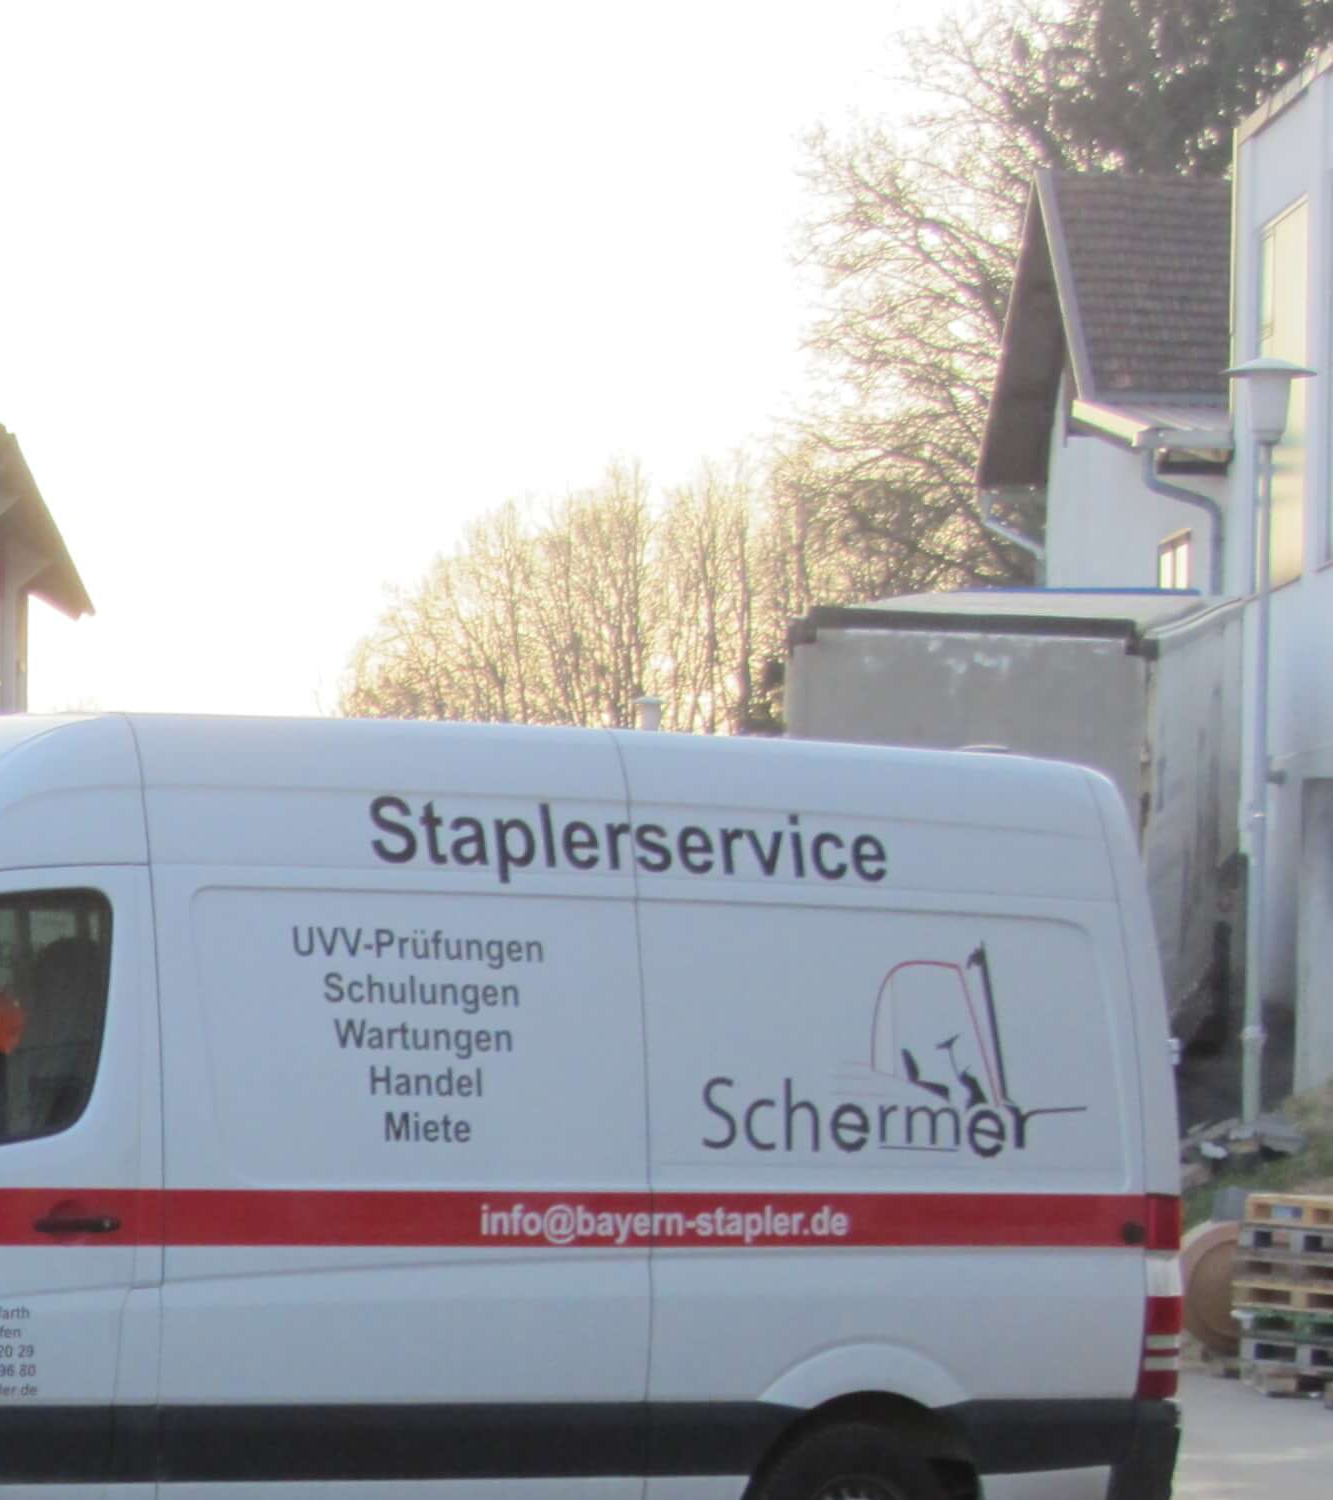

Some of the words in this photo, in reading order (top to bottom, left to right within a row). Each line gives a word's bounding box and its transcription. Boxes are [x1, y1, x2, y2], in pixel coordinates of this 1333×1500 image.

[368, 794, 889, 885] Staplerservice
[291, 924, 545, 970] UVV-Prüfungen
[322, 971, 521, 1015] Schulungen
[333, 1018, 514, 1060] Wartungen
[369, 1064, 484, 1098] Handel
[383, 1110, 473, 1144] Miete
[701, 1075, 1039, 1159] Schermer
[479, 1203, 850, 1245] info@bayern-stapler.de
